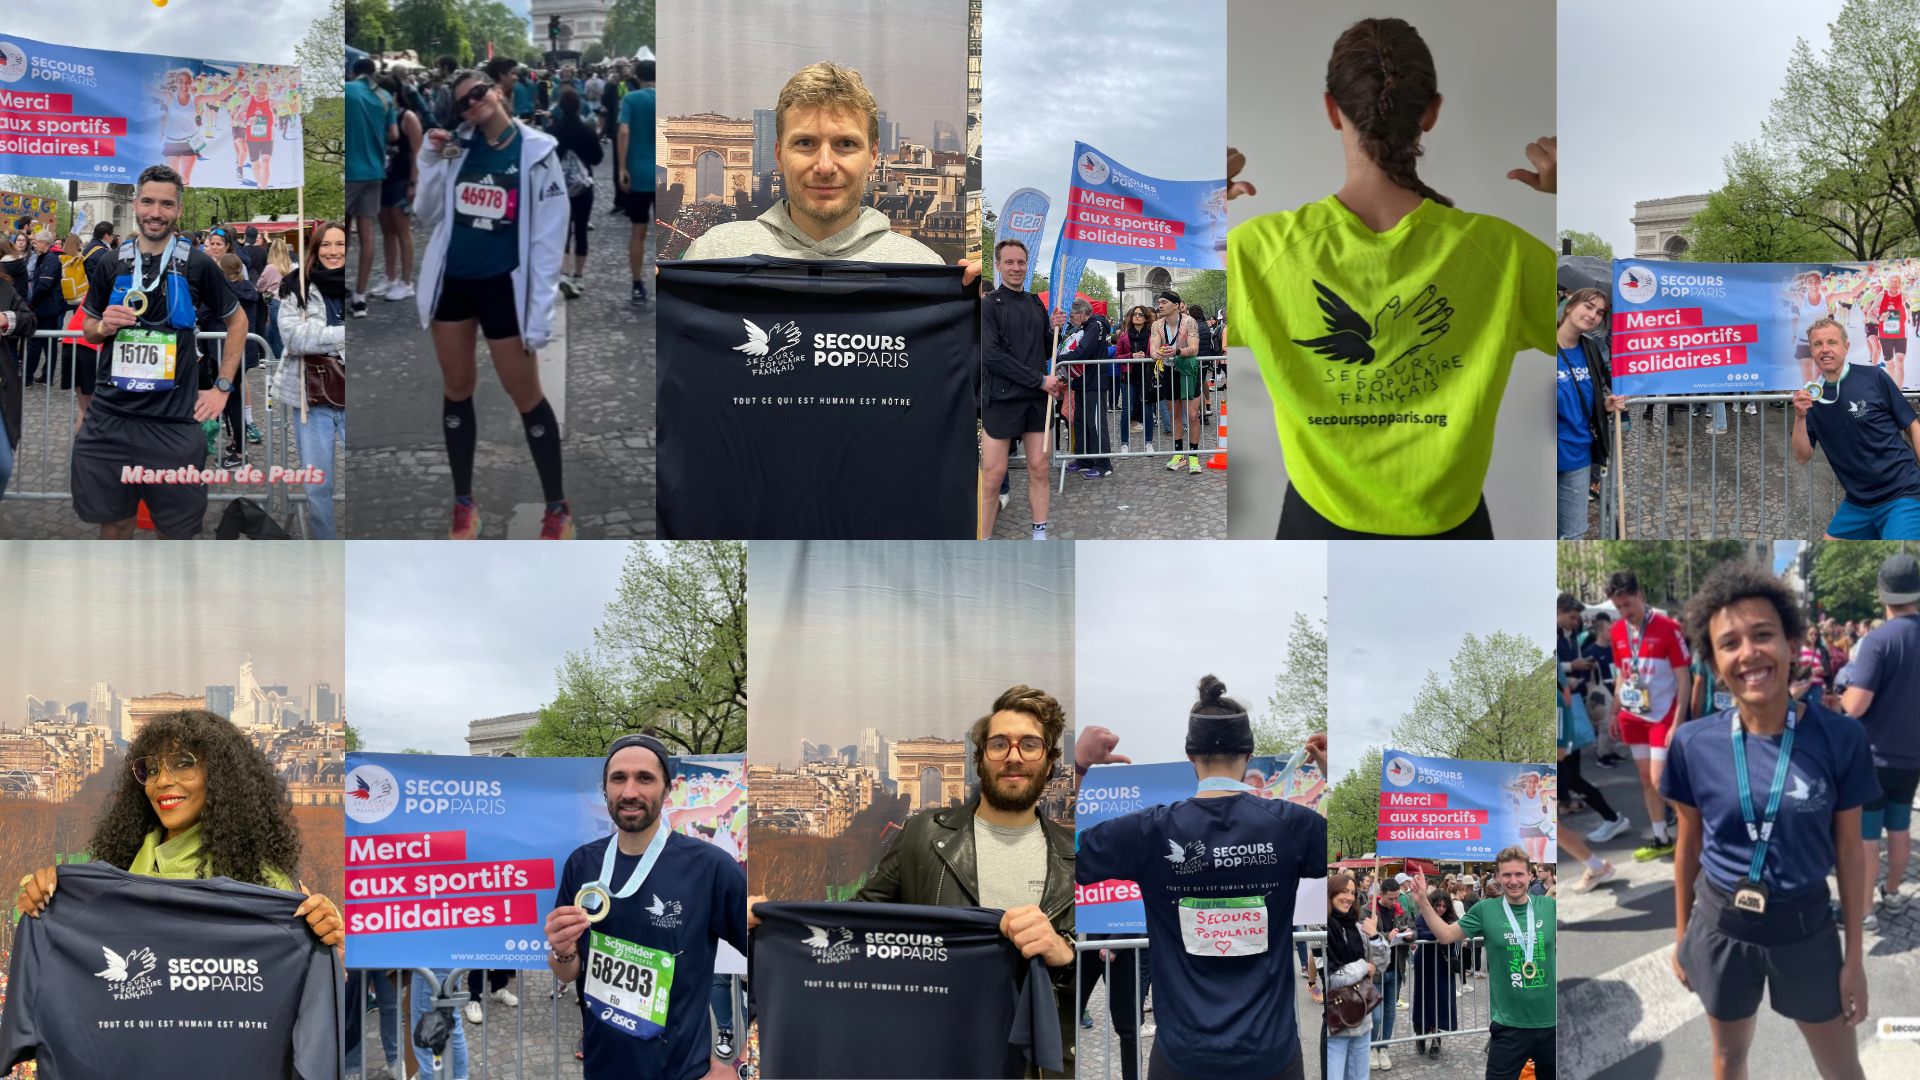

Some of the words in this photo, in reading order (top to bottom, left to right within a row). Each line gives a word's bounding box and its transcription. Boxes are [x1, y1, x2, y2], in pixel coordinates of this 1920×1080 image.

[31, 56, 95, 76] SECOURS
[0, 91, 50, 110] Merci
[0, 117, 32, 131] aux
[37, 118, 111, 136] sportifs
[0, 137, 89, 154] solidaires
[1111, 168, 1157, 193] SECOURS
[460, 186, 504, 209] 46978
[1080, 190, 1125, 210] Merci
[1079, 211, 1111, 225] aux
[1114, 216, 1172, 234] sportifs
[1078, 229, 1156, 248] solidaires
[1660, 275, 1724, 287] SECOURS
[1626, 310, 1681, 329] Merci
[125, 329, 164, 339] Schneder
[813, 333, 906, 350] SECOURS
[1627, 335, 1665, 351] aux
[1669, 327, 1742, 351] sportifs
[120, 343, 159, 365] 15176
[746, 350, 795, 367] SECOURS
[759, 354, 806, 369] POPULAIRE
[1628, 352, 1722, 374] solidaires
[1726, 349, 1731, 364] !
[751, 365, 795, 376] FRANÇAIS
[1323, 353, 1437, 383] SECOURS
[1356, 355, 1464, 392] POPULAIRE
[1337, 379, 1439, 405] FRANÇAIS
[733, 397, 757, 405] TOUT
[761, 397, 773, 405] CE
[777, 397, 793, 405] QUI
[798, 397, 815, 405] EST
[819, 397, 855, 405] HUMAIN
[860, 397, 876, 405] EST
[881, 397, 911, 406] NÔTRE
[1307, 411, 1448, 427] secourspopparis.org
[1418, 767, 1463, 780] SECOURS
[404, 779, 502, 796] SECOURS
[1078, 786, 1140, 800] ECOURS
[1077, 800, 1143, 815] OPPARIS
[1390, 793, 1431, 806] Merci
[1390, 813, 1418, 823] aux
[1421, 811, 1476, 826] sportifs
[1390, 827, 1461, 840] solidaires
[1464, 827, 1469, 839] !
[350, 834, 431, 862] Merci
[1213, 842, 1274, 858] SECOURS
[349, 875, 407, 897] aux
[414, 864, 528, 899] sportifs
[1075, 882, 1141, 903] daires
[1195, 900, 1211, 909] RUN
[350, 902, 496, 932] solidaires
[504, 899, 512, 923] !
[1196, 911, 1261, 925] SECOURS
[604, 936, 656, 960] Schneider
[864, 932, 945, 947] SECOURS
[1536, 931, 1547, 961] FINISHER
[168, 958, 259, 974] SECOURS
[450, 952, 548, 963] www.secourspopparis
[624, 952, 654, 967] Electric
[591, 952, 653, 998] 58293
[1509, 958, 1524, 988] 2024
[108, 976, 152, 991] SECOURS
[120, 979, 163, 994] POPULAIRE
[656, 986, 668, 998] 4h
[837, 981, 851, 989] QUI
[871, 983, 901, 991] HUMAIN
[923, 985, 949, 994] NÔTRE
[113, 989, 153, 1001] FRANÇAIS
[610, 994, 620, 1006] Flo
[98, 1020, 121, 1029] TOUT
[124, 1020, 135, 1028] CE
[139, 1020, 154, 1028] QUI
[158, 1020, 174, 1028] EST
[178, 1020, 213, 1028] HUMAIN
[218, 1020, 234, 1028] EST
[238, 1020, 268, 1029] NÔTRE
[611, 1012, 638, 1032] asics
